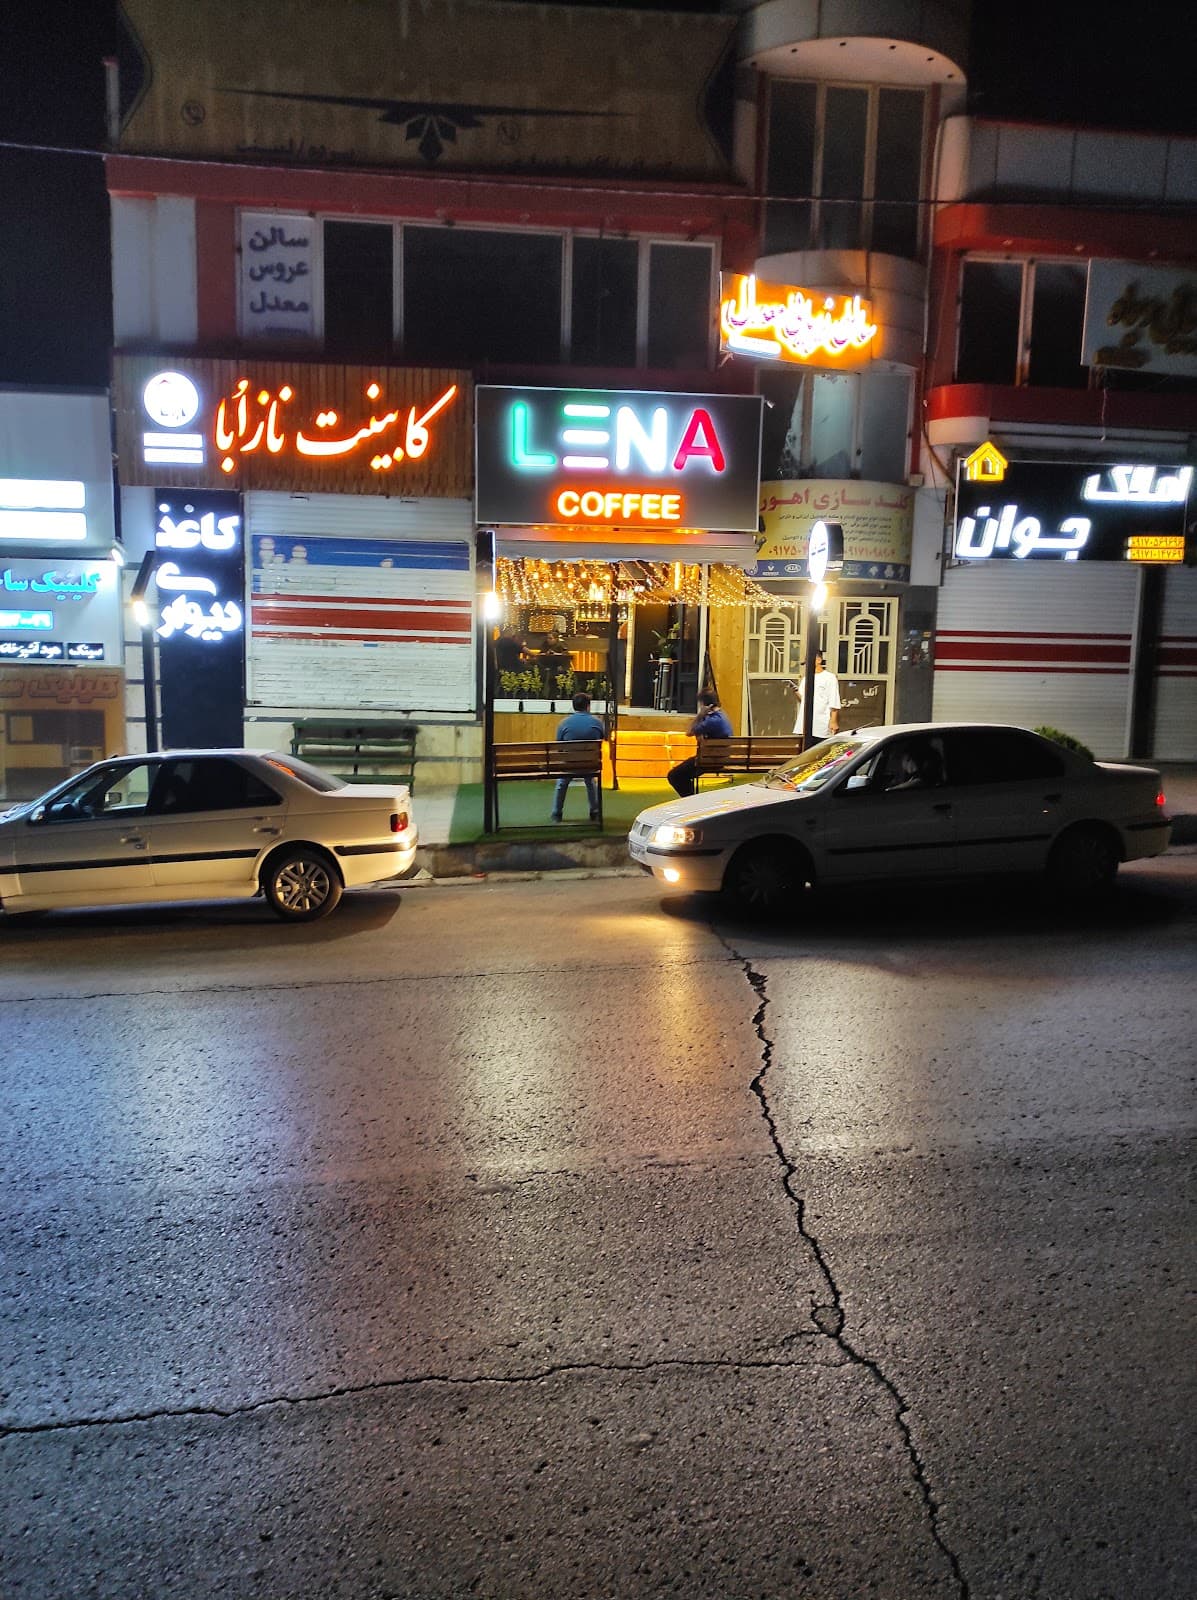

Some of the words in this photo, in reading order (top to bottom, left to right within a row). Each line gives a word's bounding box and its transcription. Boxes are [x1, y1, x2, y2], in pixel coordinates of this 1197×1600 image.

[249, 226, 309, 252] سالن
[249, 261, 309, 284] عروس
[249, 291, 309, 314] معدل
[295, 383, 457, 471] کابینت
[509, 400, 727, 473] LENA
[1083, 465, 1193, 502] املاک
[557, 491, 681, 520] COFFEE
[813, 488, 871, 510] سازی
[155, 503, 240, 550] کاغذ
[956, 504, 1092, 560] جوان
[30, 570, 101, 600] کلینیک
